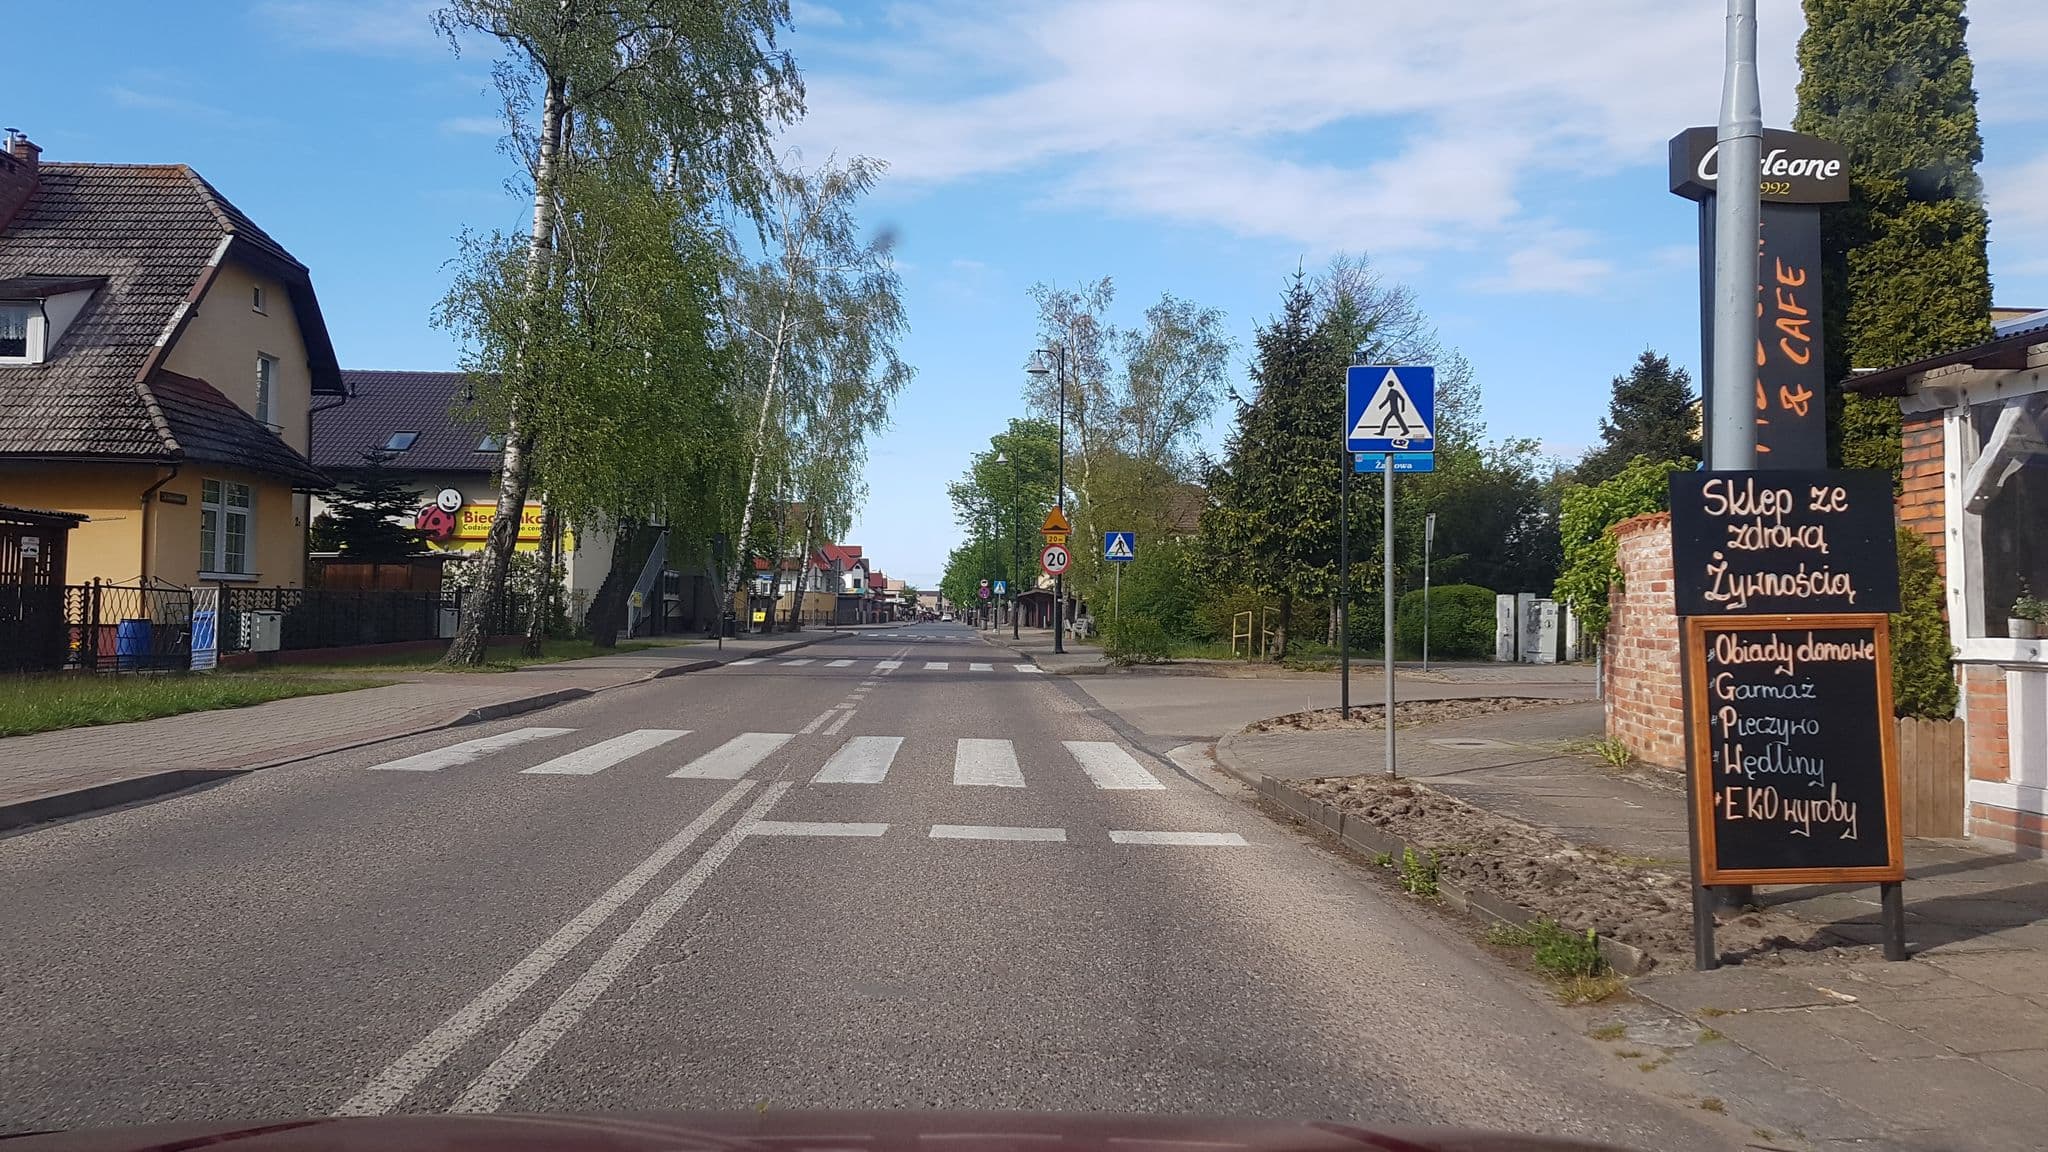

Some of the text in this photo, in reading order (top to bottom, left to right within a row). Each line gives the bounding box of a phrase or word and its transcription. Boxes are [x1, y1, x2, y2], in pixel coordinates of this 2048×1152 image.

[1760, 181, 1791, 194] 992
[1776, 257, 1813, 416] & CAFE
[1375, 460, 1412, 469] Żaowa
[1703, 478, 1849, 526] Sklep ze
[1727, 516, 1829, 555] zdrową
[1047, 552, 1066, 566] 20
[1704, 551, 1857, 610] Żywnością
[1716, 631, 1875, 676] Obiady domowe
[1716, 672, 1817, 702] Garmaż
[1719, 706, 1820, 746] Pieczywo
[1724, 743, 1825, 787] Wędliny
[1725, 782, 1858, 840] EKO wyroby
